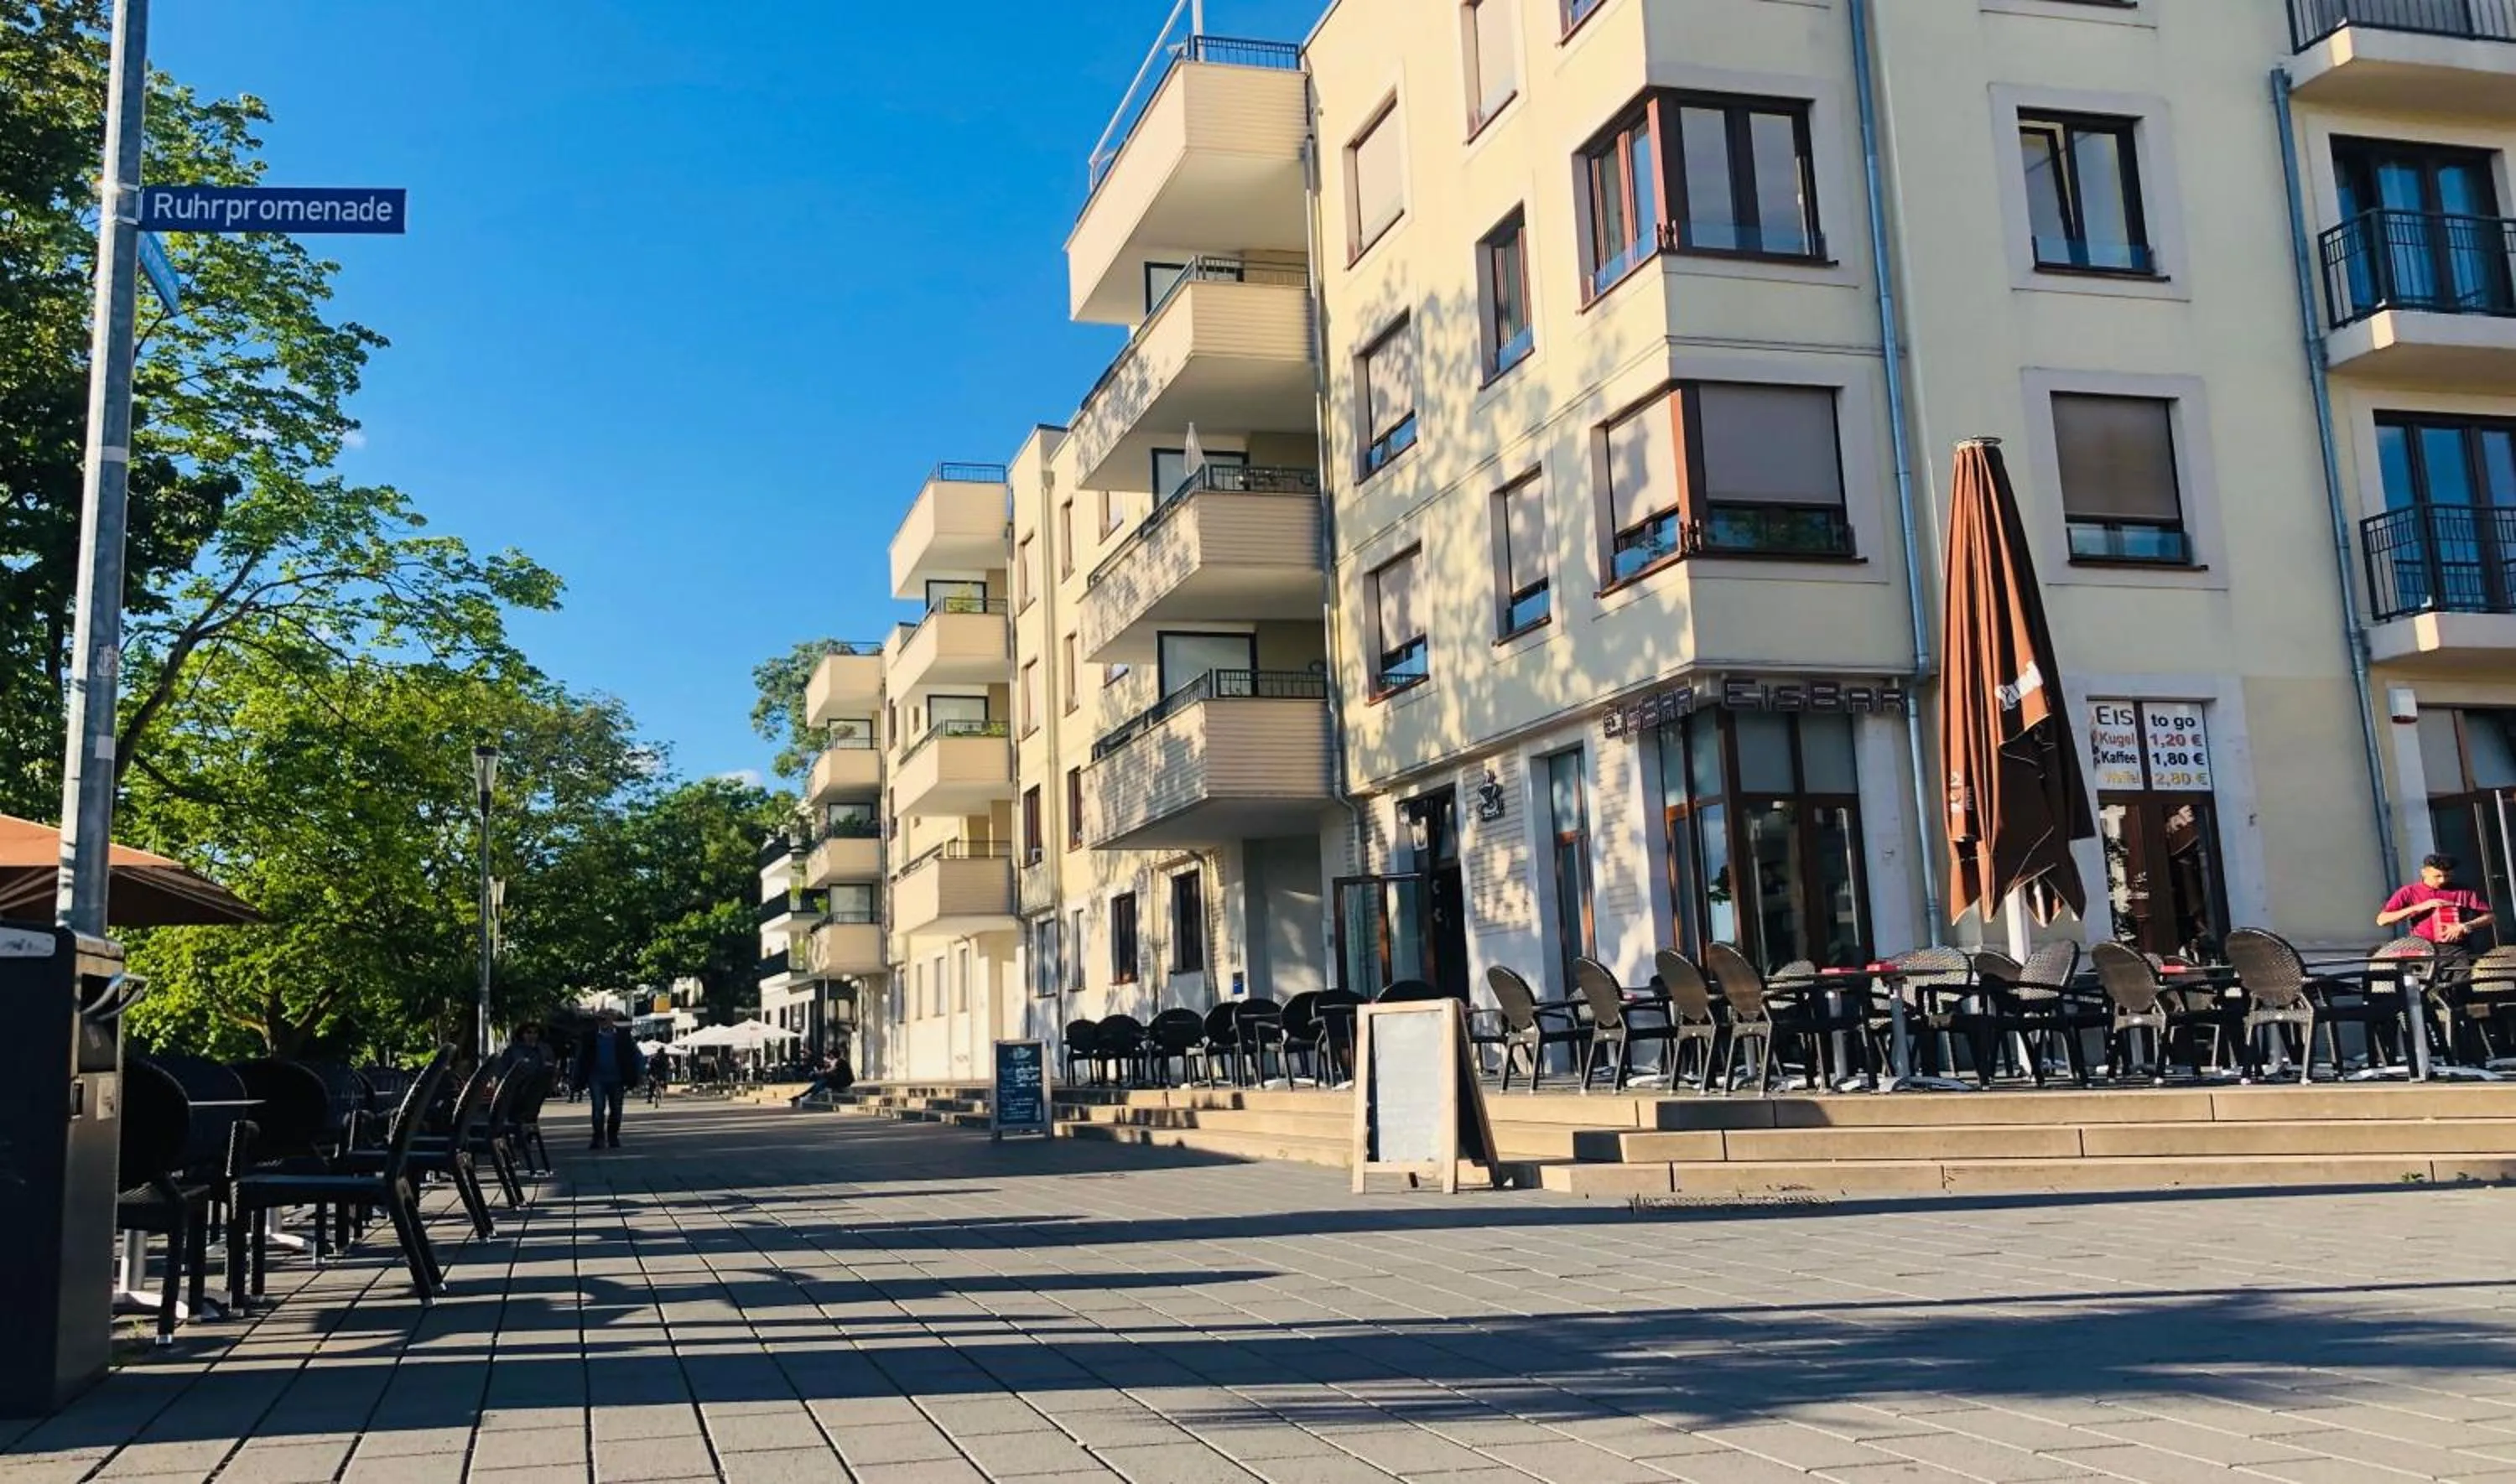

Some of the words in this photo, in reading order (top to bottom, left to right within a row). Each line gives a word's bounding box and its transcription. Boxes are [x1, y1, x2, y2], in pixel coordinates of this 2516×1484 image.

[153, 193, 393, 226] Ruhrpromenade
[2150, 713, 2169, 727] to
[2174, 716, 2196, 730] go
[2099, 731, 2135, 748] Kugel
[2150, 734, 2186, 748] 1,20
[2191, 734, 2203, 747] €
[2101, 751, 2138, 765] Kaffee
[2151, 752, 2188, 767] 1,80
[2194, 753, 2206, 765] €
[2154, 771, 2191, 787] 2,80
[2196, 772, 2209, 786] €
